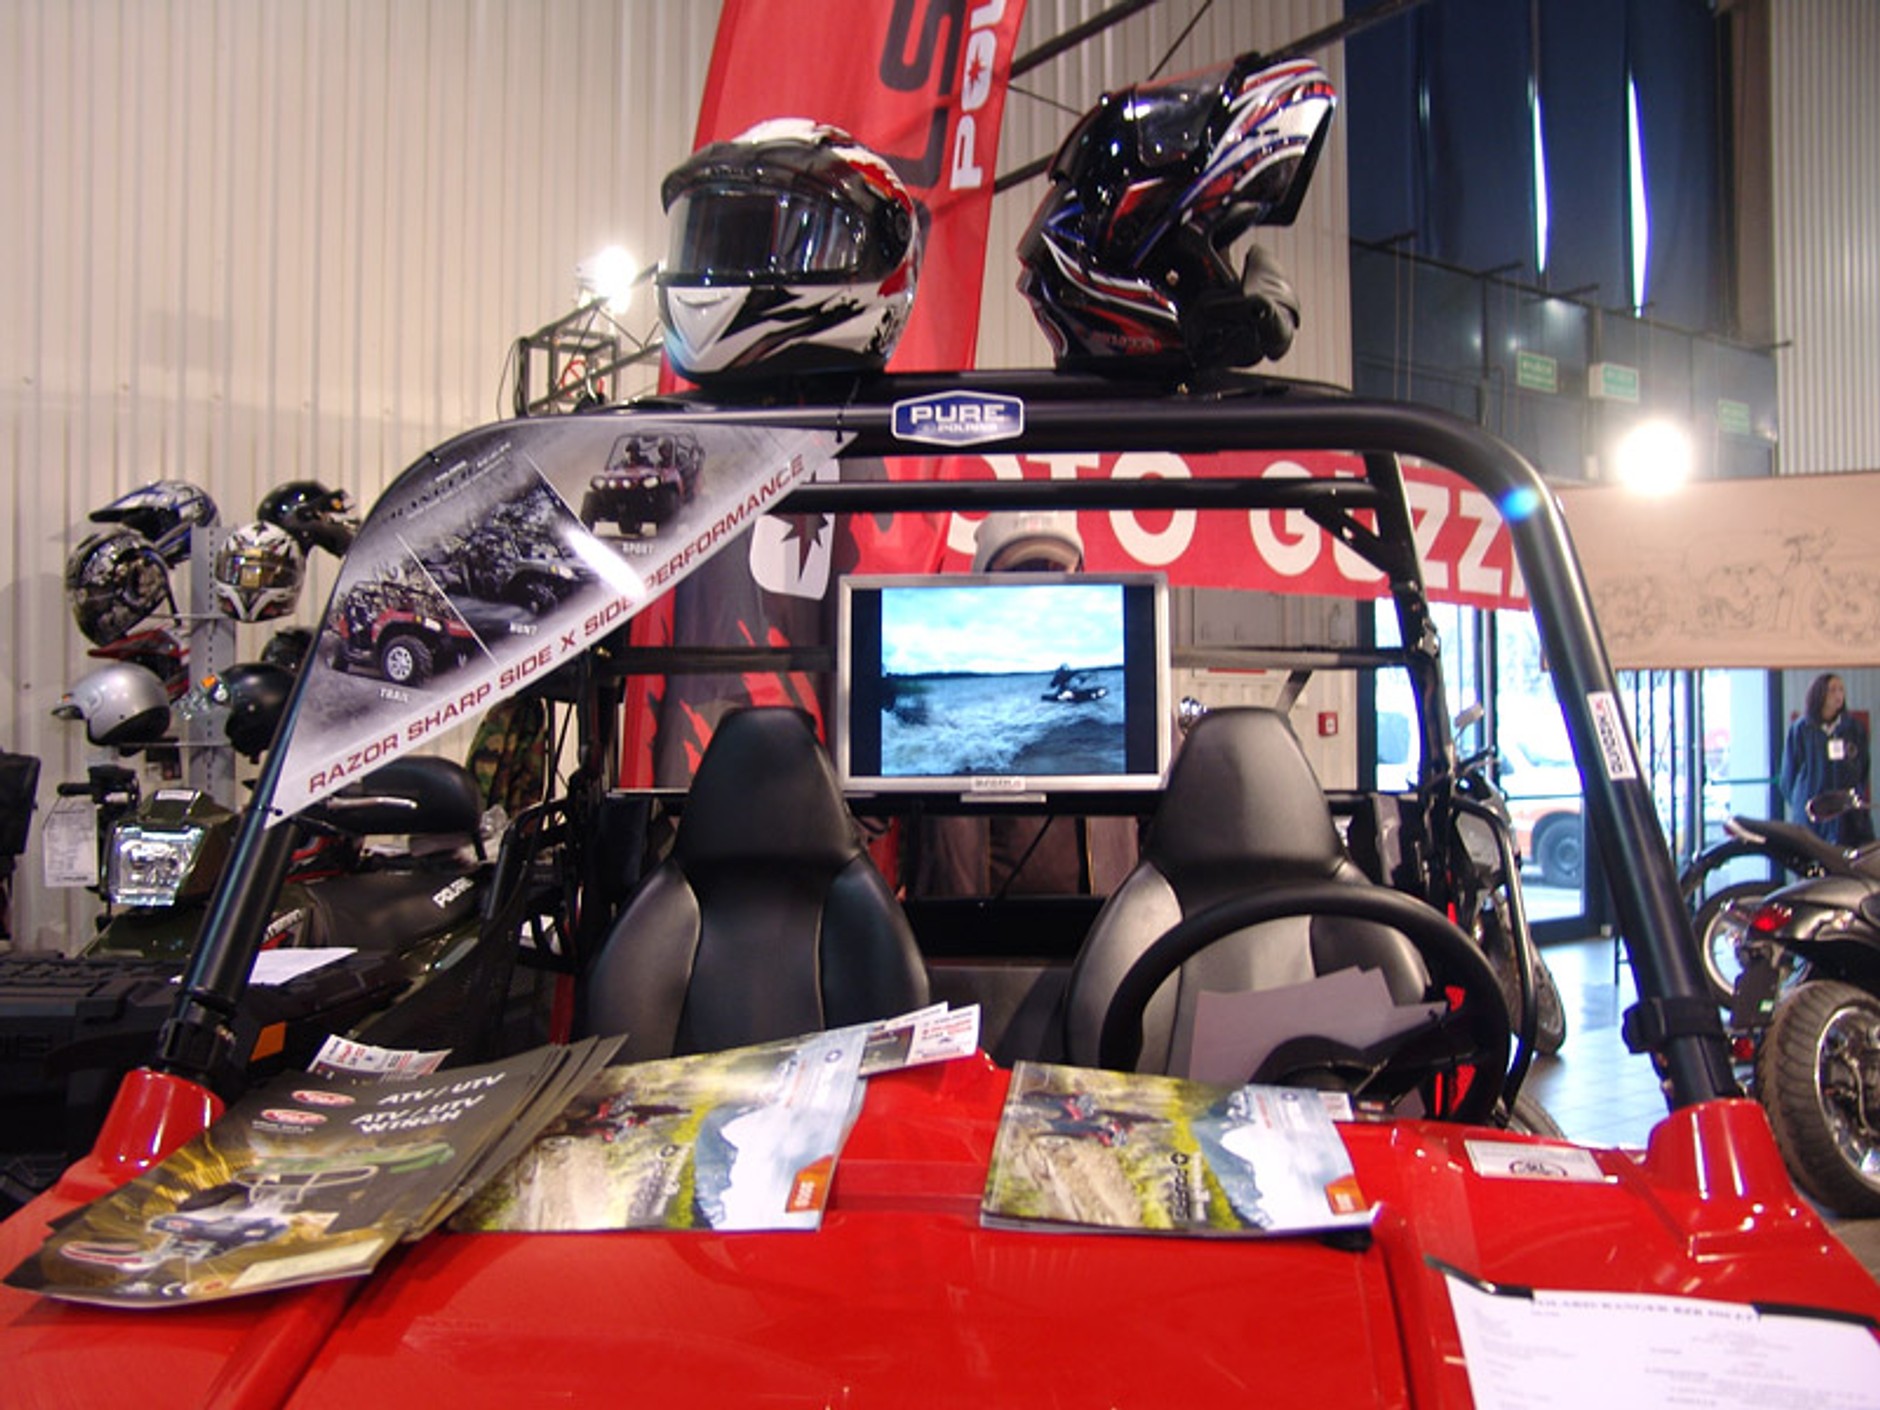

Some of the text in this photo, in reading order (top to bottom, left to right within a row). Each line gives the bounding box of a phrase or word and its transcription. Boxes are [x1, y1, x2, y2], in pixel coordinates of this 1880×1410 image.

[911, 404, 1005, 424] PURE
[309, 734, 399, 794] RAZOR
[407, 683, 491, 742] SHARP
[499, 646, 553, 690] SIDE
[560, 631, 577, 653] X
[645, 454, 805, 589] PERFORMANCE
[378, 1089, 435, 1105] ATV
[451, 1072, 506, 1094] UTV
[350, 1108, 410, 1125] ATV
[429, 1094, 486, 1114] UTV
